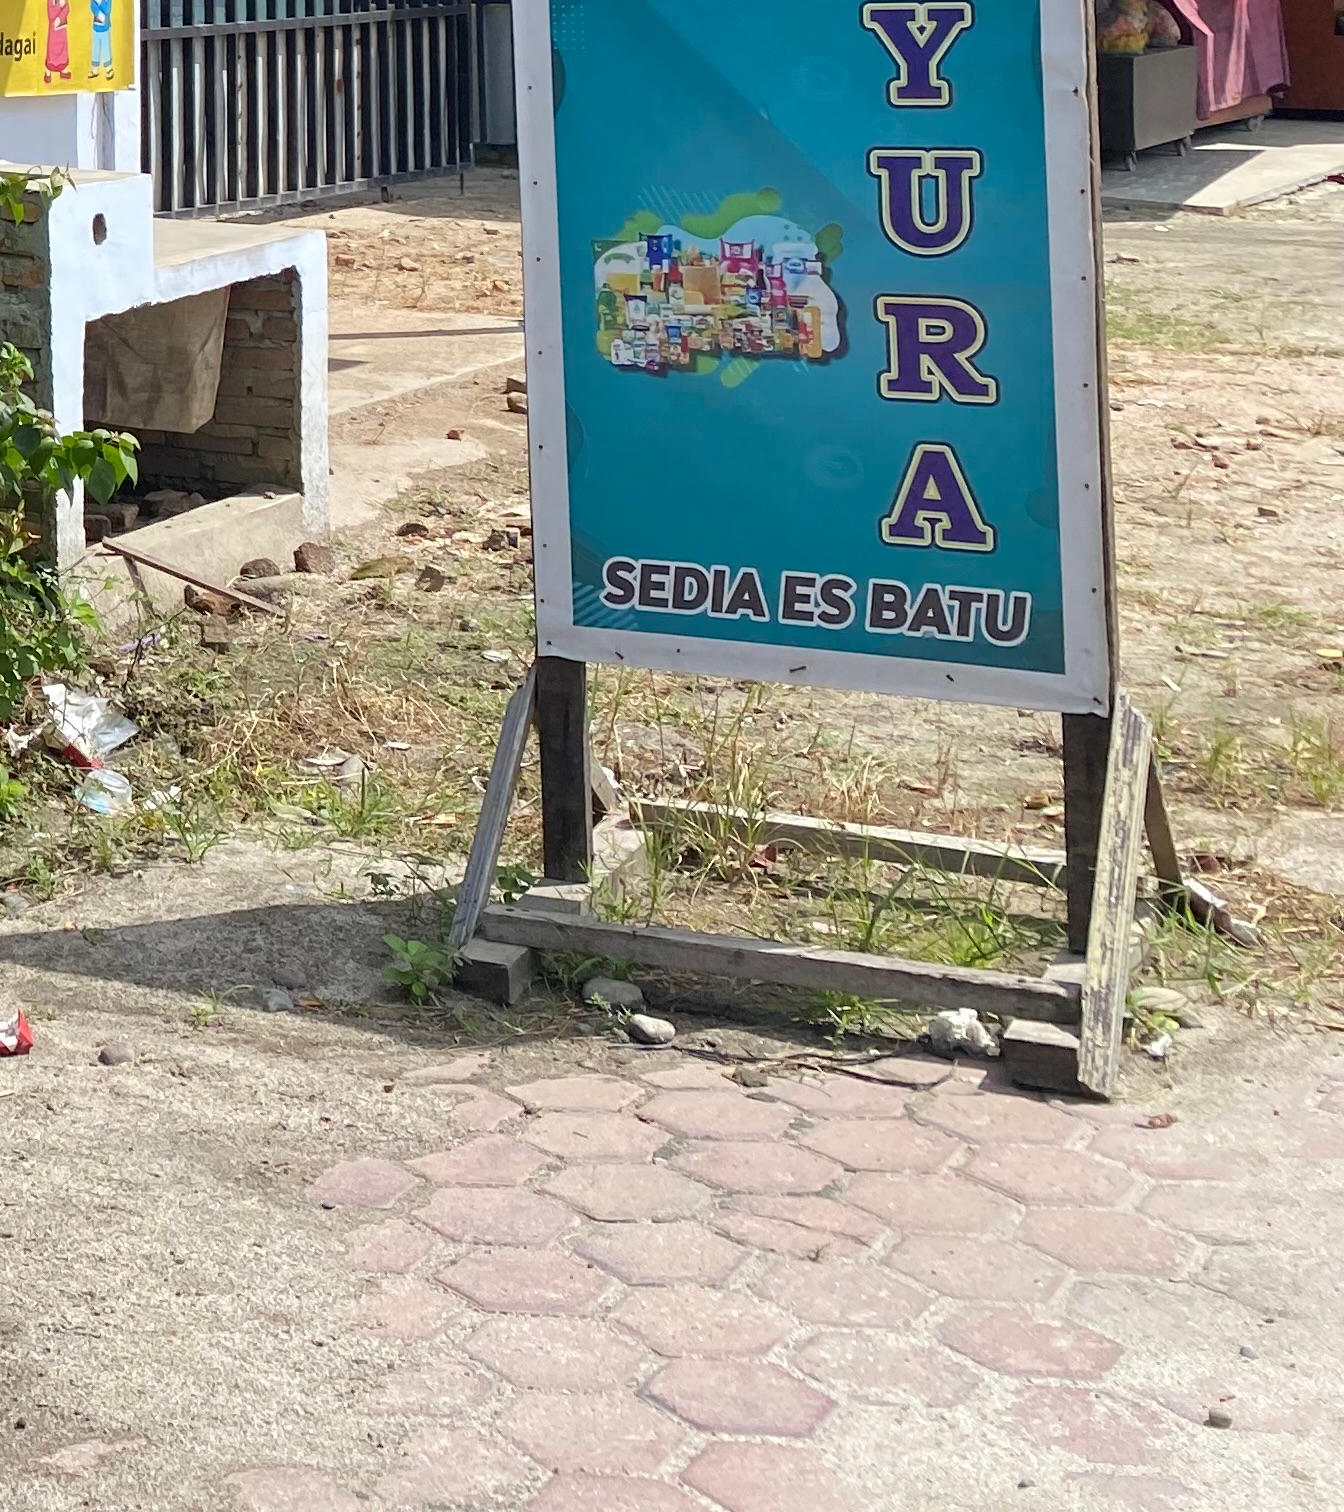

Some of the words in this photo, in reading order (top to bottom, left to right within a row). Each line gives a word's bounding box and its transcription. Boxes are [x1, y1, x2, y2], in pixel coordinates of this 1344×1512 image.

[861, 0, 999, 553] YURA
[601, 557, 771, 623] SEDIA
[779, 570, 858, 630] ES
[865, 577, 1033, 648] BATU
